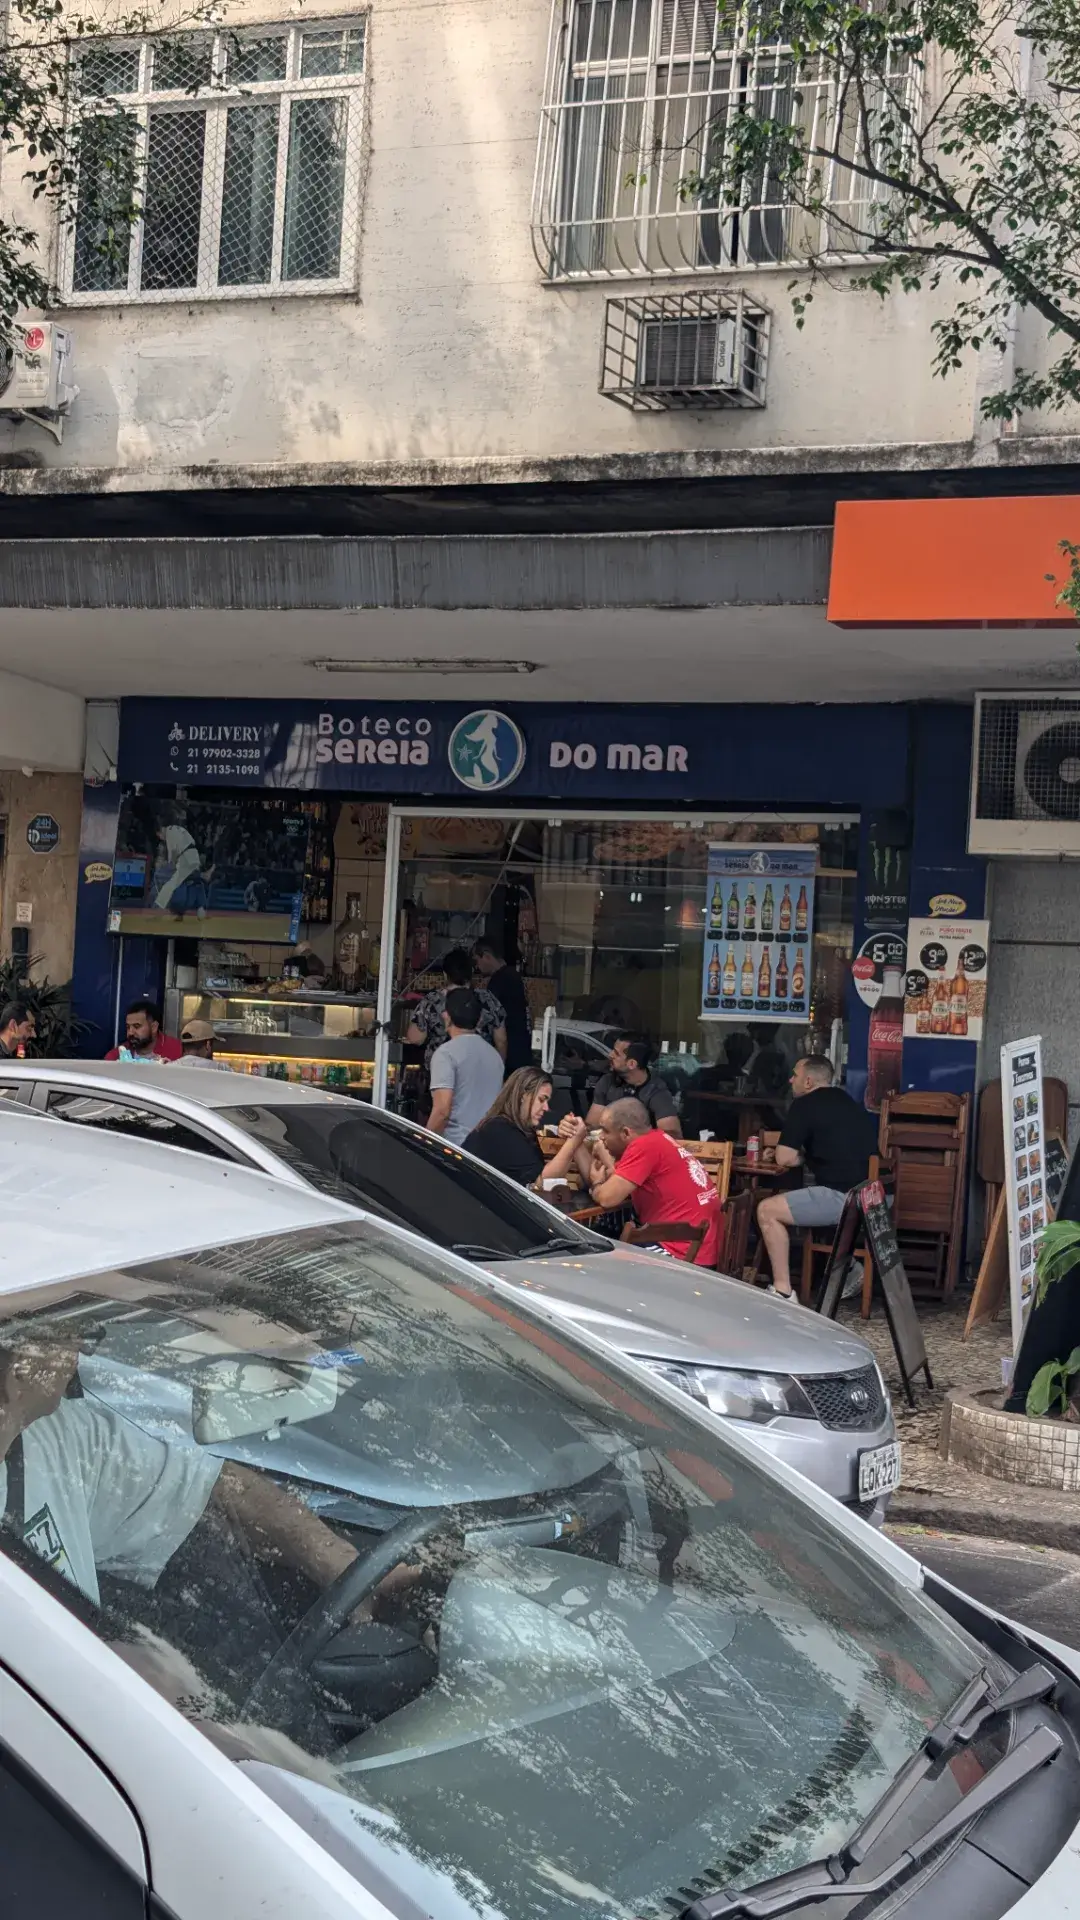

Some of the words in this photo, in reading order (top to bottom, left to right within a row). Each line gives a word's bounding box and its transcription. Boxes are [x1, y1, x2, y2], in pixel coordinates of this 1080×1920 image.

[717, 340, 726, 368] Consul
[189, 726, 263, 742] DELIVERY
[318, 713, 432, 736] Boteco
[187, 748, 199, 758] 21
[203, 748, 261, 759] 97902-3328
[550, 741, 597, 770] DO
[187, 764, 198, 774] 21
[206, 764, 260, 775] 2135-1098
